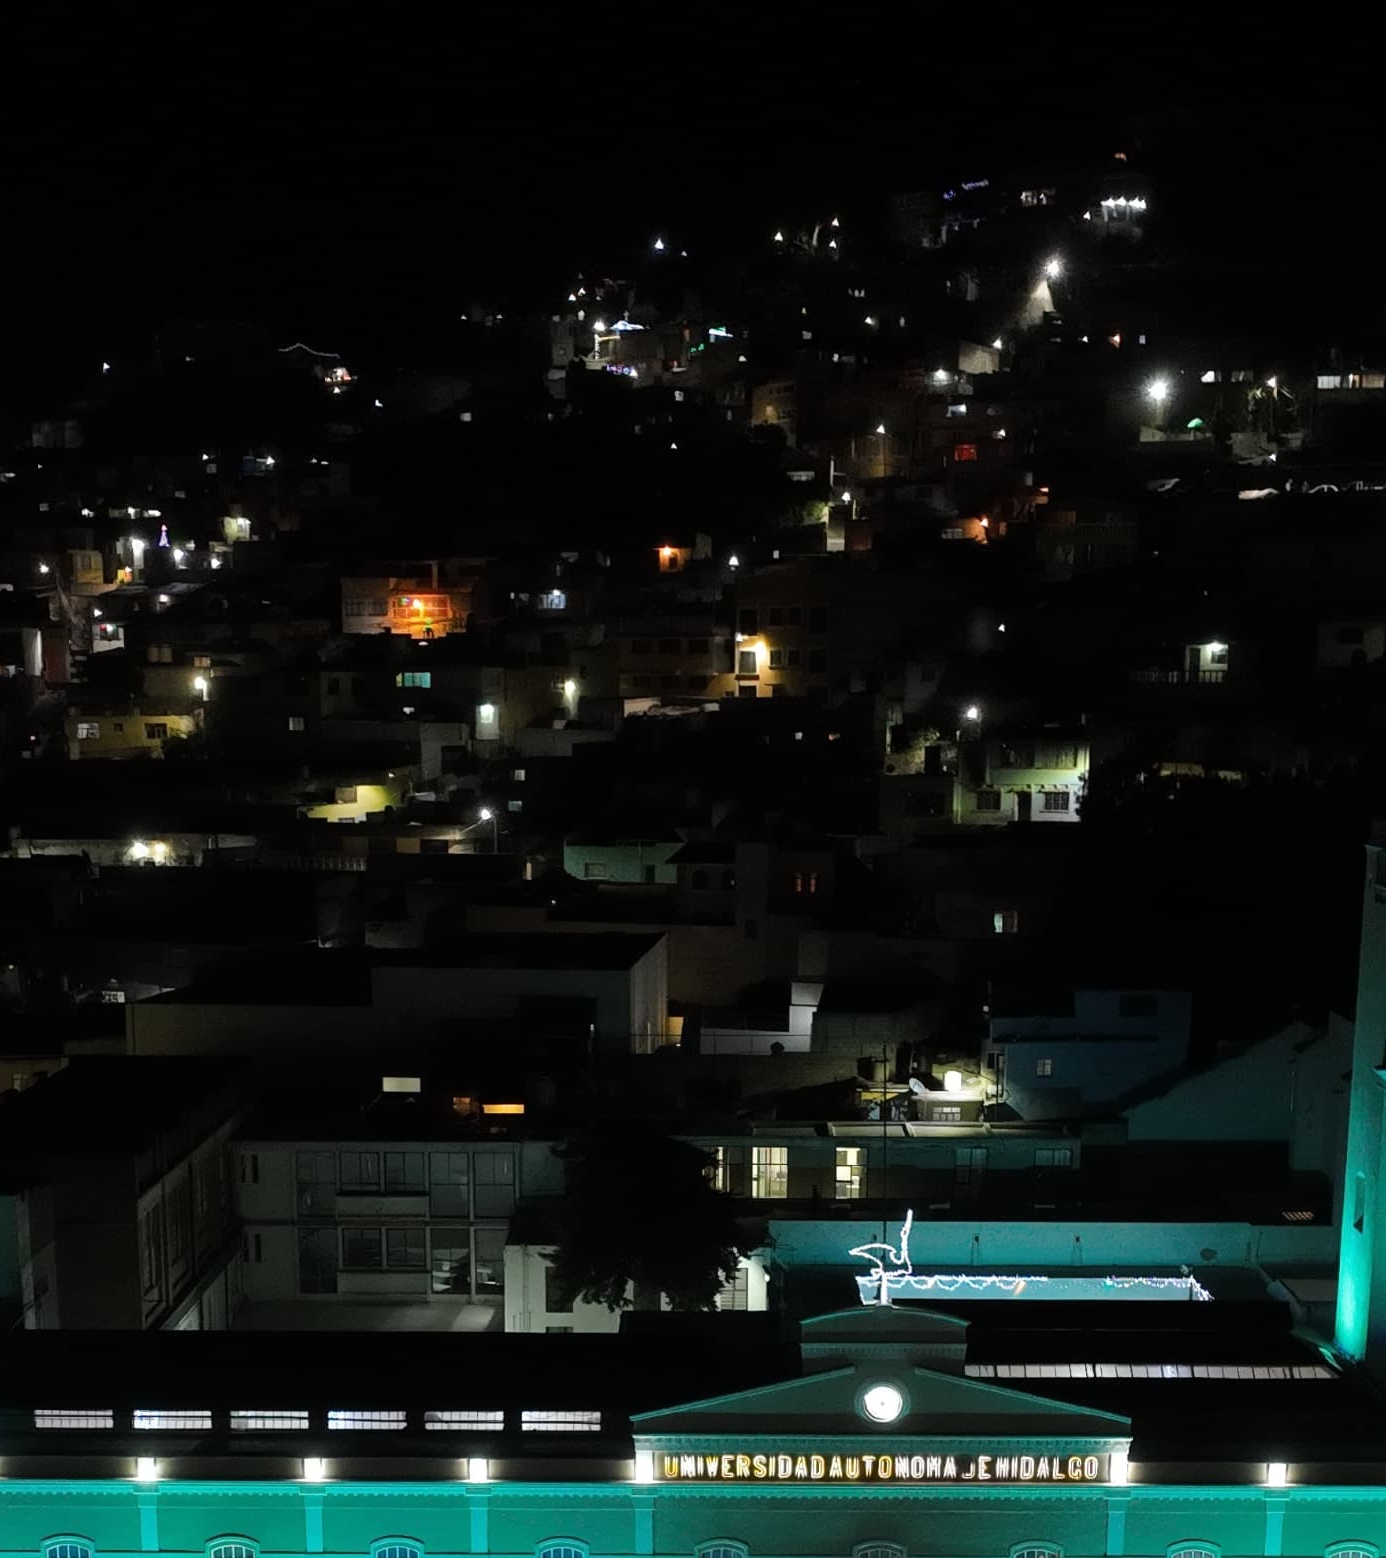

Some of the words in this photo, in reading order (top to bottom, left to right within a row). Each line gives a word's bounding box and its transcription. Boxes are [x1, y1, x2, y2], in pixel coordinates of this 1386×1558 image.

[663, 1454, 826, 1479] UNIVERSIDAD
[828, 1455, 957, 1479] AUTONOMA
[995, 1456, 1099, 1480] HIDALGO
